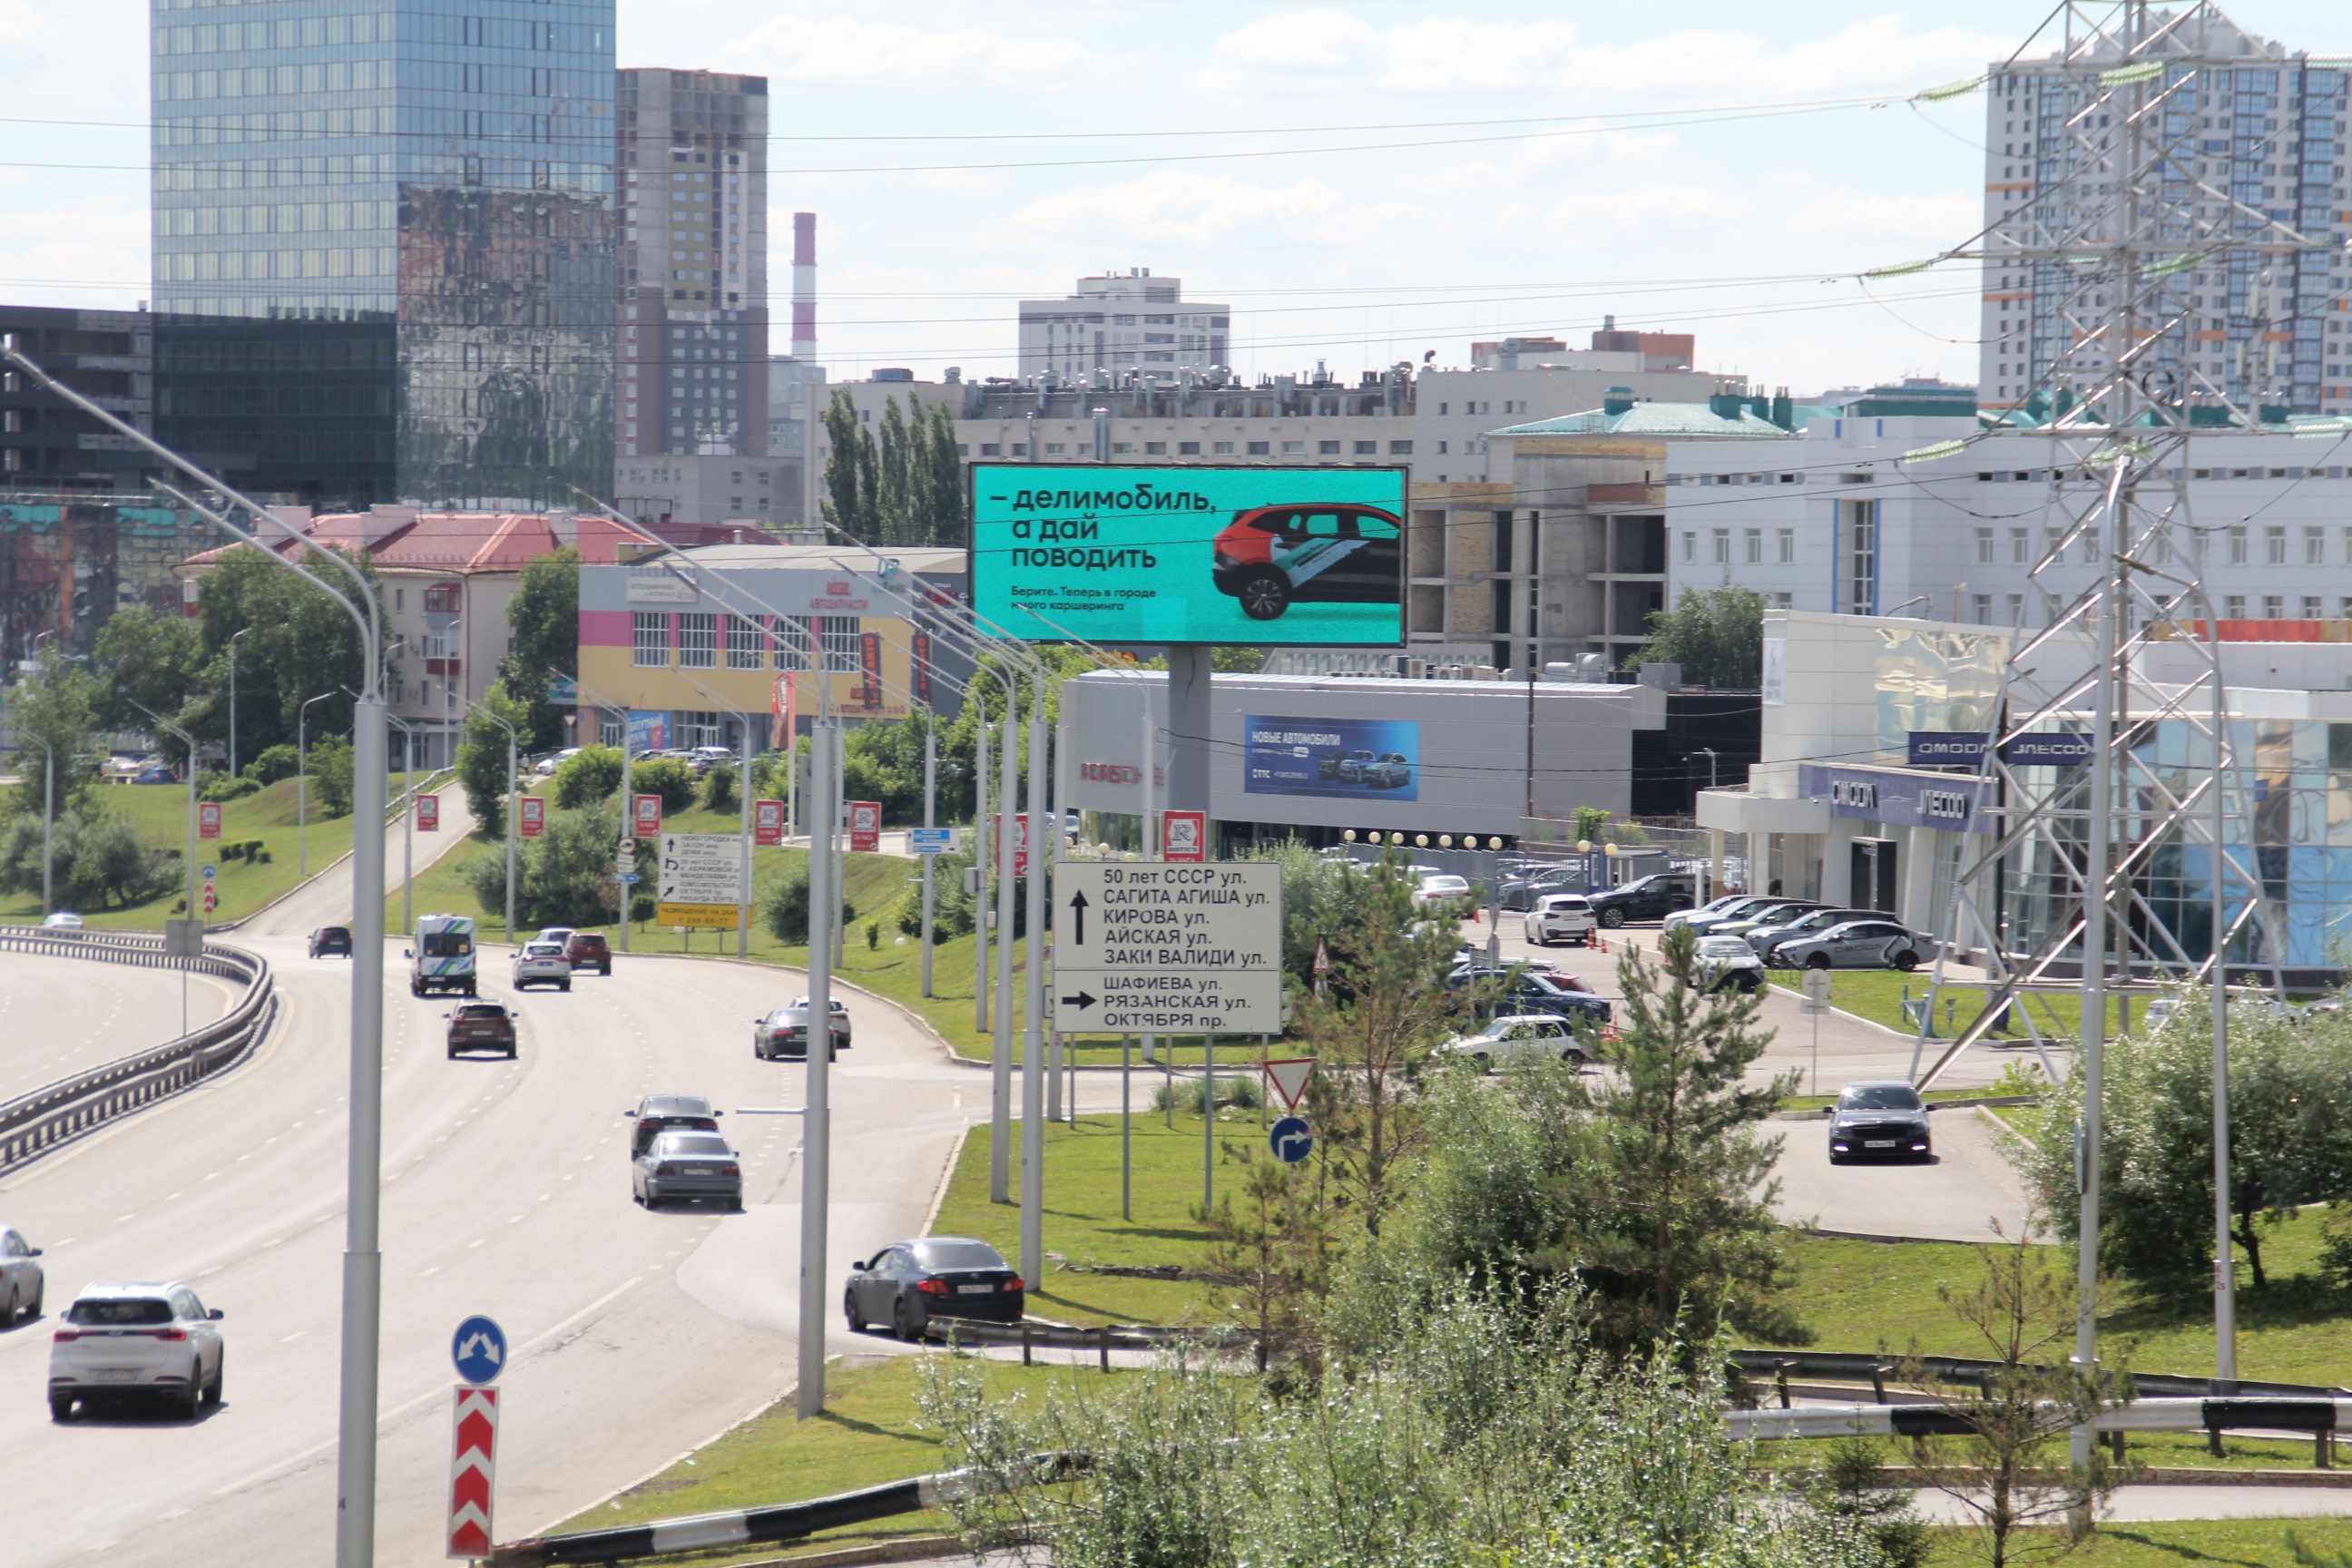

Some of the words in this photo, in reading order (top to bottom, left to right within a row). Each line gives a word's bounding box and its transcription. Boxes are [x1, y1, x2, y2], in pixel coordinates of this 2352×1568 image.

[1013, 484, 1216, 514] делимобиль,
[1012, 520, 1031, 538] а
[1039, 513, 1098, 543] дай
[1012, 548, 1157, 572] поводить
[1011, 586, 1057, 598] Берите.
[1061, 586, 1102, 600] Теперь
[1104, 589, 1112, 597] в
[1114, 589, 1157, 600] городе
[1050, 601, 1124, 613] каршеринга
[1251, 730, 1282, 744] НОВЫЕ
[1282, 733, 1341, 746] АВТОМОБИЛИ
[1103, 868, 1123, 885] 50
[1128, 872, 1159, 884] лет
[1164, 868, 1215, 885] СССР
[1220, 872, 1247, 887] ул.
[1103, 888, 1171, 905] САГИТА
[1176, 888, 1240, 905] АГИША
[1245, 893, 1270, 907] ул.
[1103, 909, 1179, 925] КИРОВА
[1184, 913, 1210, 927] ул.
[1104, 926, 1181, 944] АЙСКАЯ
[1186, 933, 1212, 947] ул.
[1103, 949, 1152, 965] ЗАКИ
[1158, 949, 1235, 967] ВАЛИДИ
[1240, 953, 1267, 968] ул.
[1103, 976, 1193, 990] ШАФИЕВА
[1198, 979, 1222, 993] ул.
[1103, 995, 1219, 1008] РЯЗАНСКАЯ
[1224, 998, 1251, 1011] ул.
[1103, 1013, 1193, 1026] ОКТЯБРЯ
[1200, 1016, 1226, 1029] пр.
